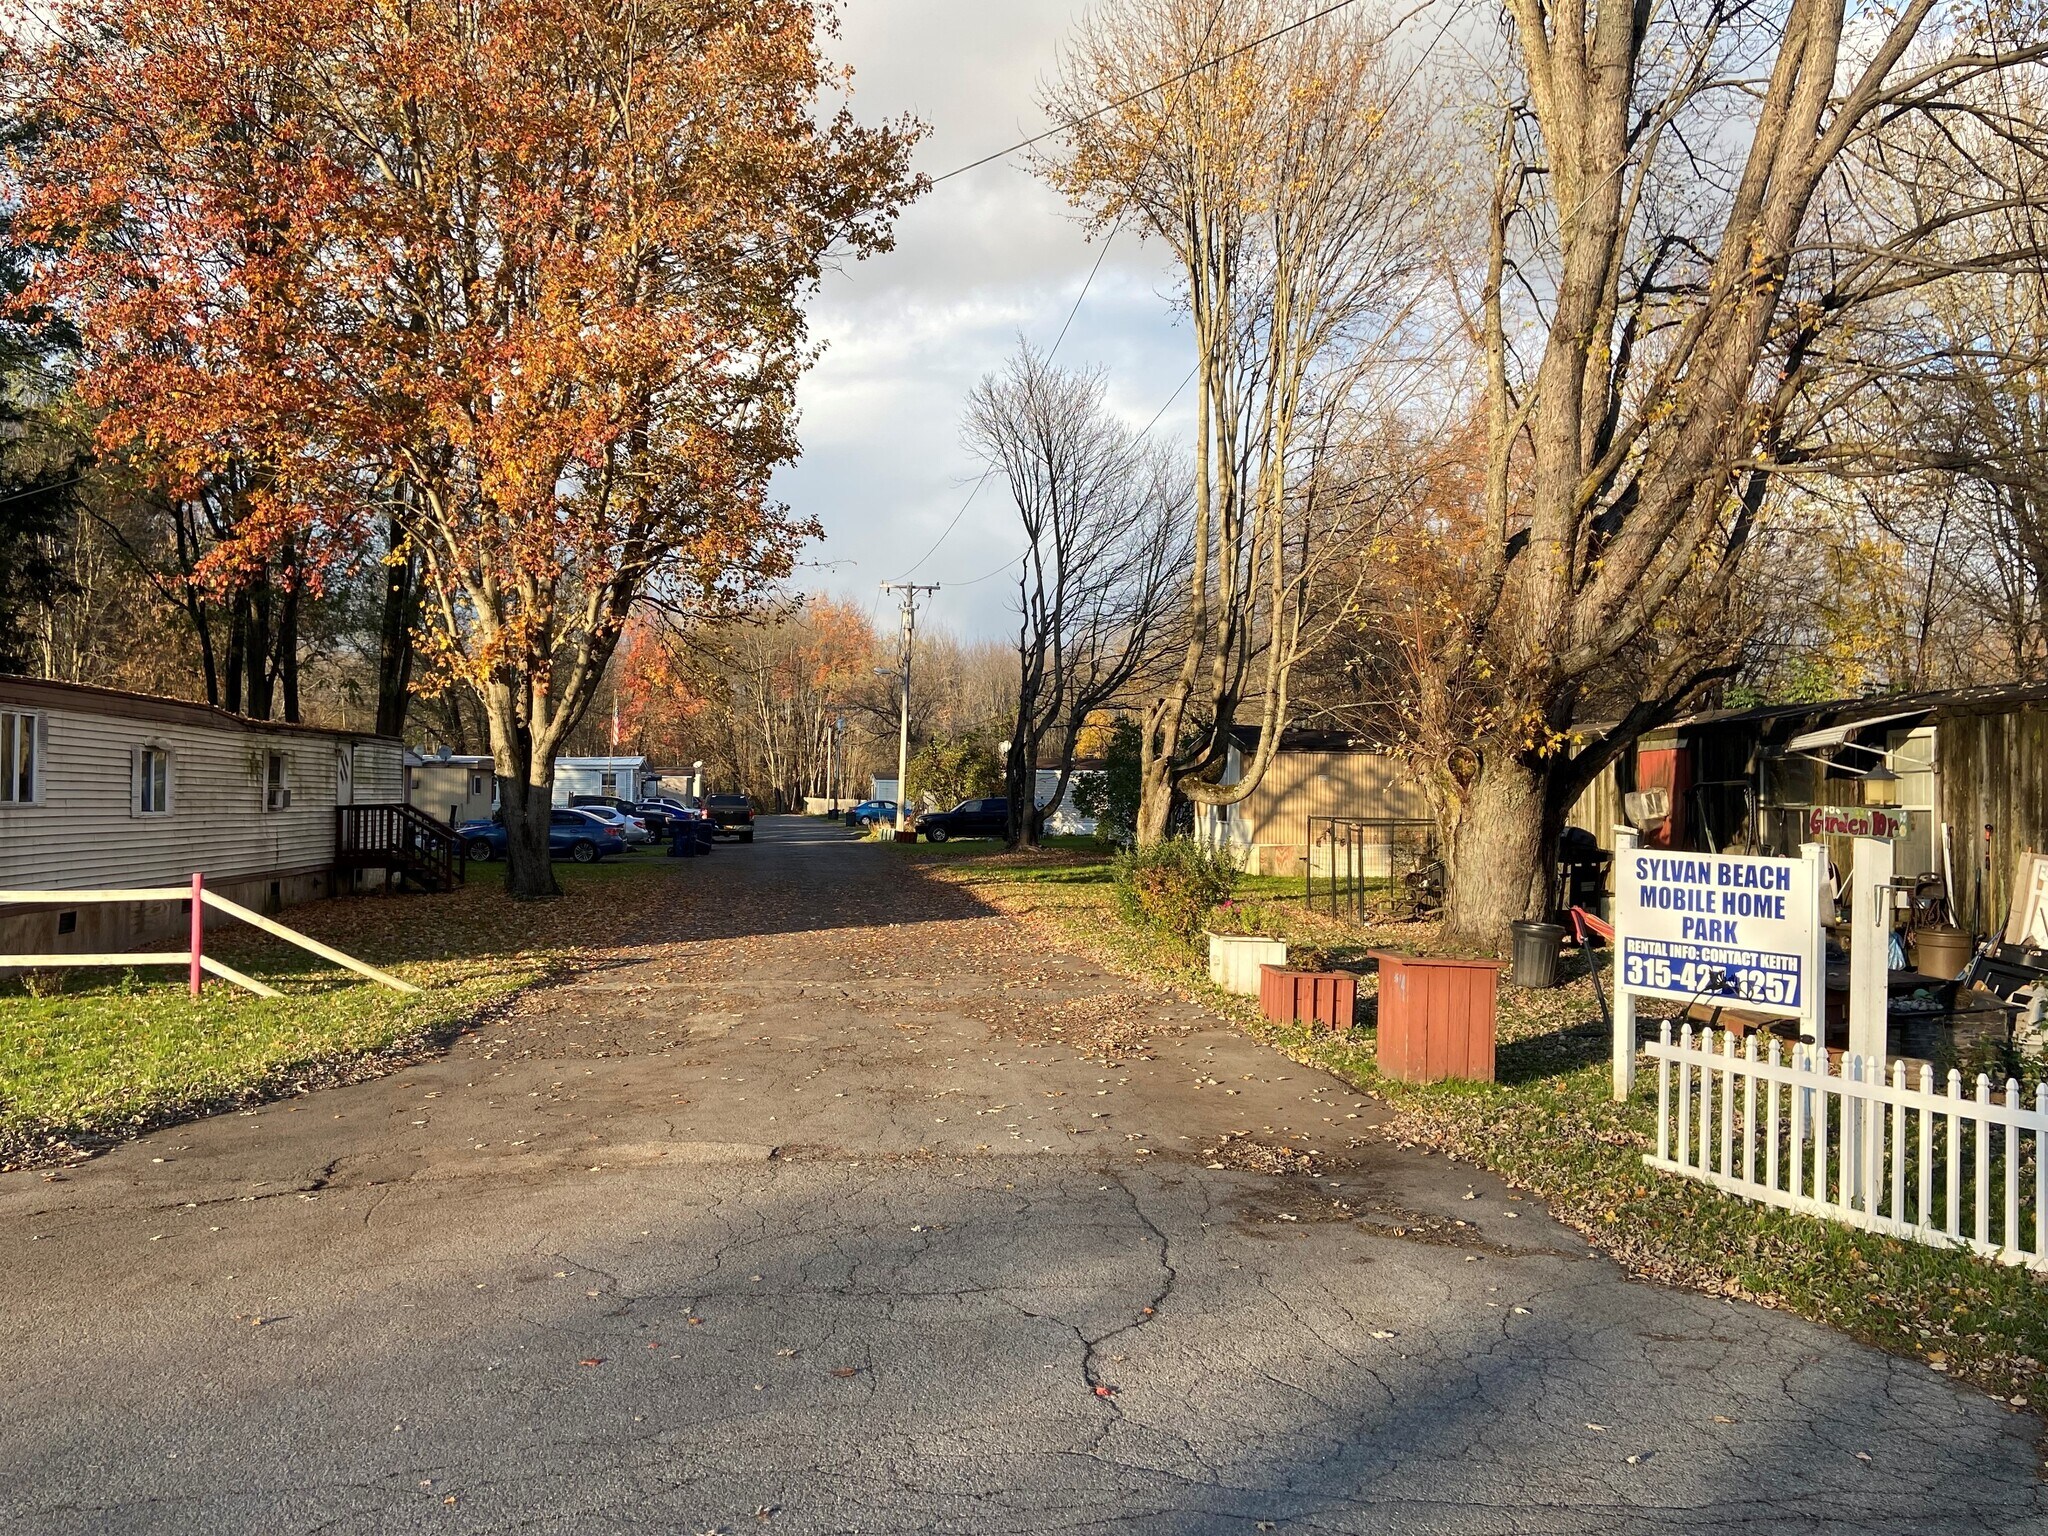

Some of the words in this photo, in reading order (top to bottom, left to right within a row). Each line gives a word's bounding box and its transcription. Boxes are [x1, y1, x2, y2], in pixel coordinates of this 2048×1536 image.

[1810, 808, 1868, 835] Garden
[1636, 857, 1711, 885] SYLVAN
[1717, 863, 1791, 891] BEACH
[1640, 885, 1716, 913] MOBILE
[1722, 892, 1786, 920] HOME
[1682, 916, 1738, 944] PARK
[1627, 939, 1667, 957] RENTAL
[1669, 943, 1700, 961] INFO:
[1701, 947, 1759, 967] CONTACT
[1760, 953, 1798, 972] KEITH
